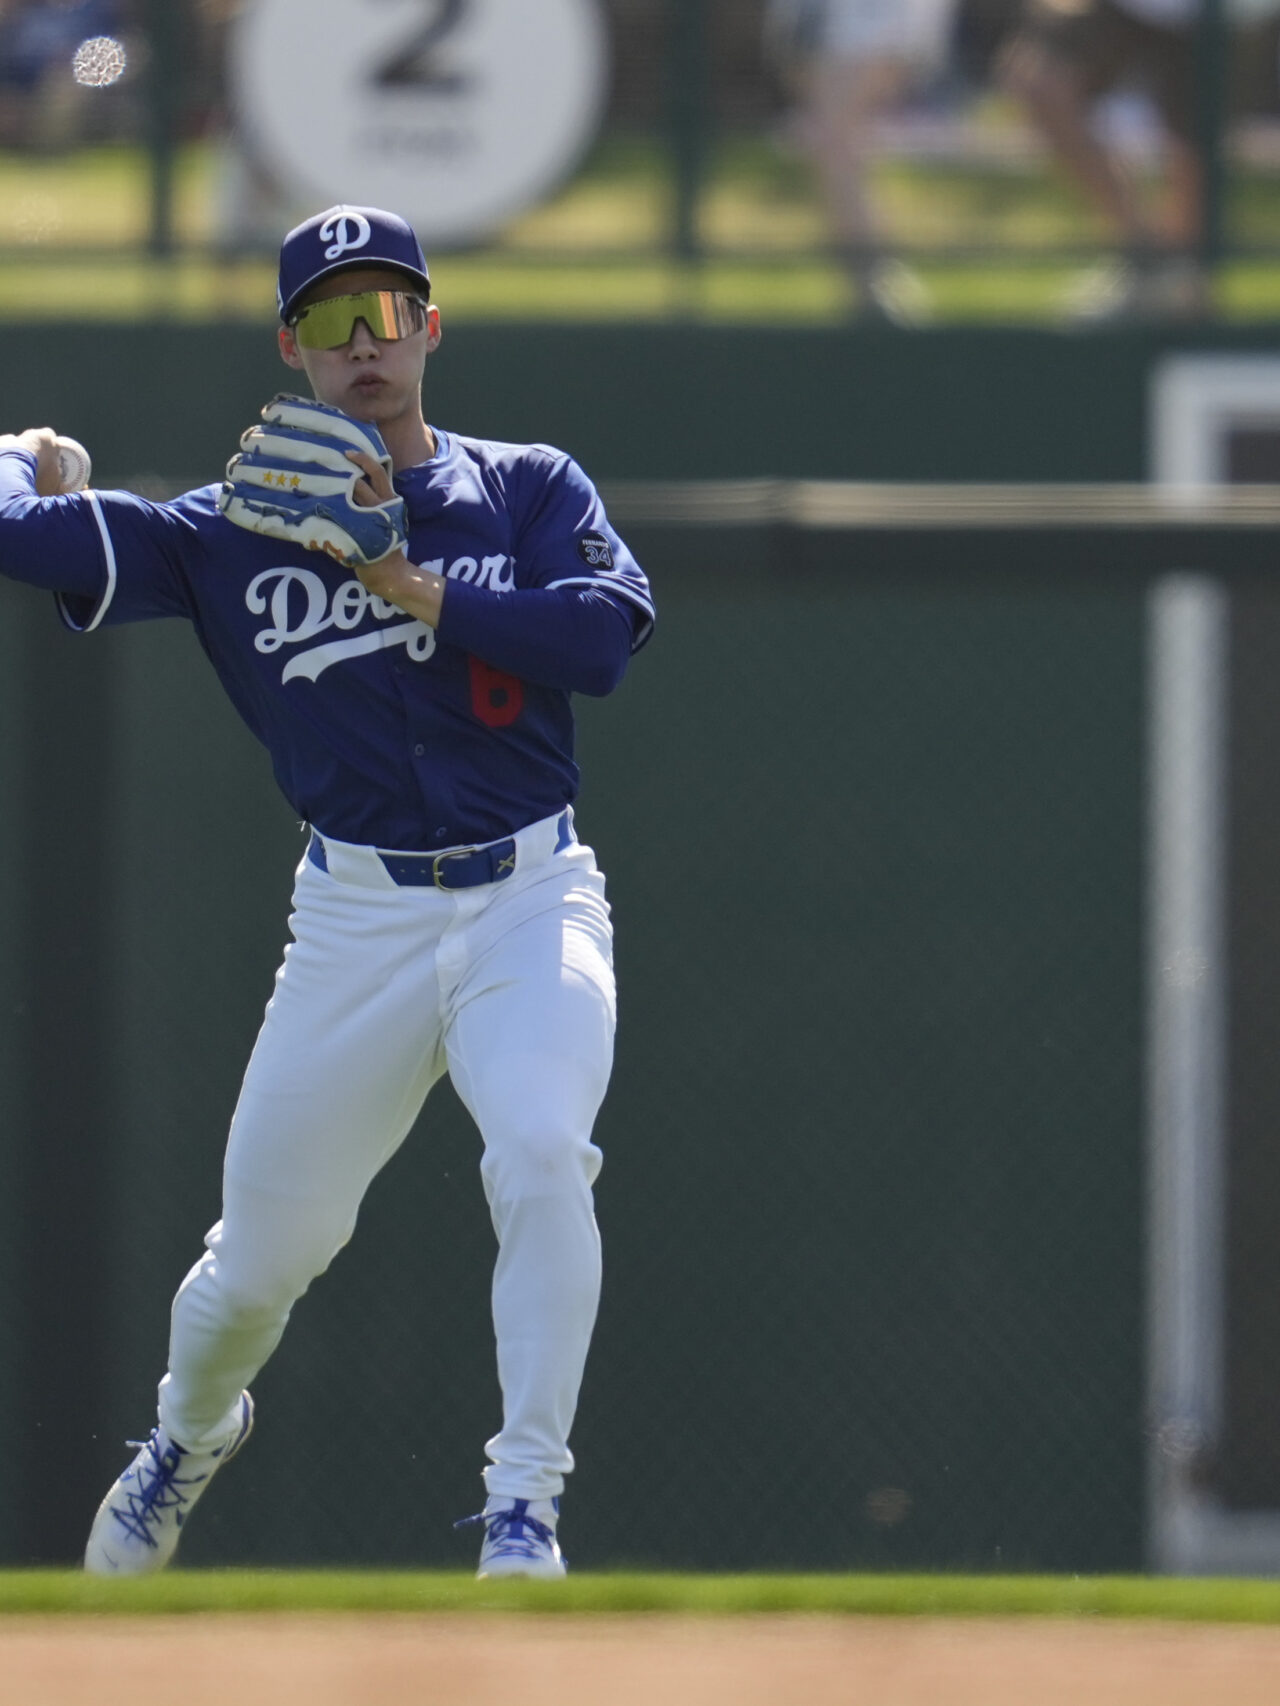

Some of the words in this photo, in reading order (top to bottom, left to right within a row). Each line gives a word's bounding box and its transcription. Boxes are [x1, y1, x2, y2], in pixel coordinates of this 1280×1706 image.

[319, 211, 371, 261] D
[584, 545, 612, 567] 34
[469, 653, 524, 728] 6
